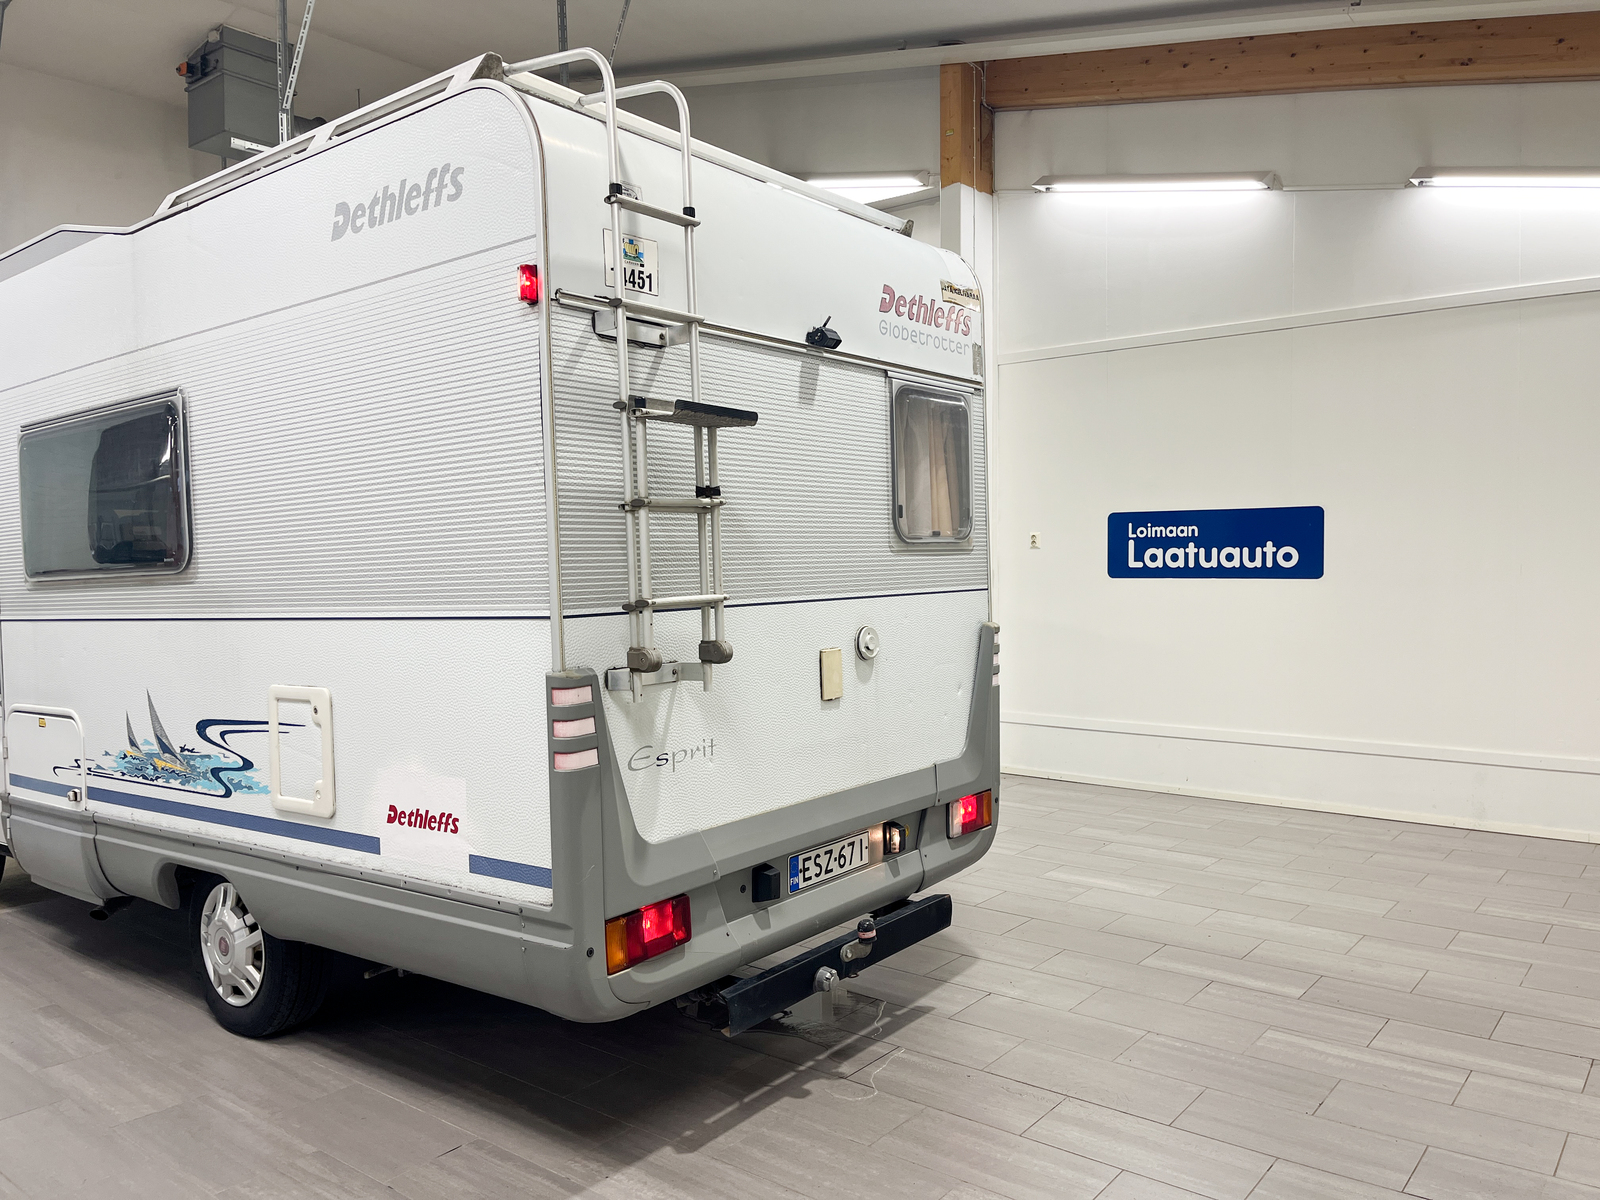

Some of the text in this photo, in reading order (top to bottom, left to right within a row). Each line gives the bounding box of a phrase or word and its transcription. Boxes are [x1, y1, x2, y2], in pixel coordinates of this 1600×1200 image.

[331, 163, 464, 242] Dethleffs
[879, 284, 971, 336] Dethleffs
[879, 319, 970, 355] Globetrotter
[1128, 522, 1199, 538] Loimaan
[1128, 539, 1300, 569] Laatuauto
[627, 738, 717, 773] Esprit
[386, 804, 460, 835] Dethleffs
[789, 876, 799, 886] FIN
